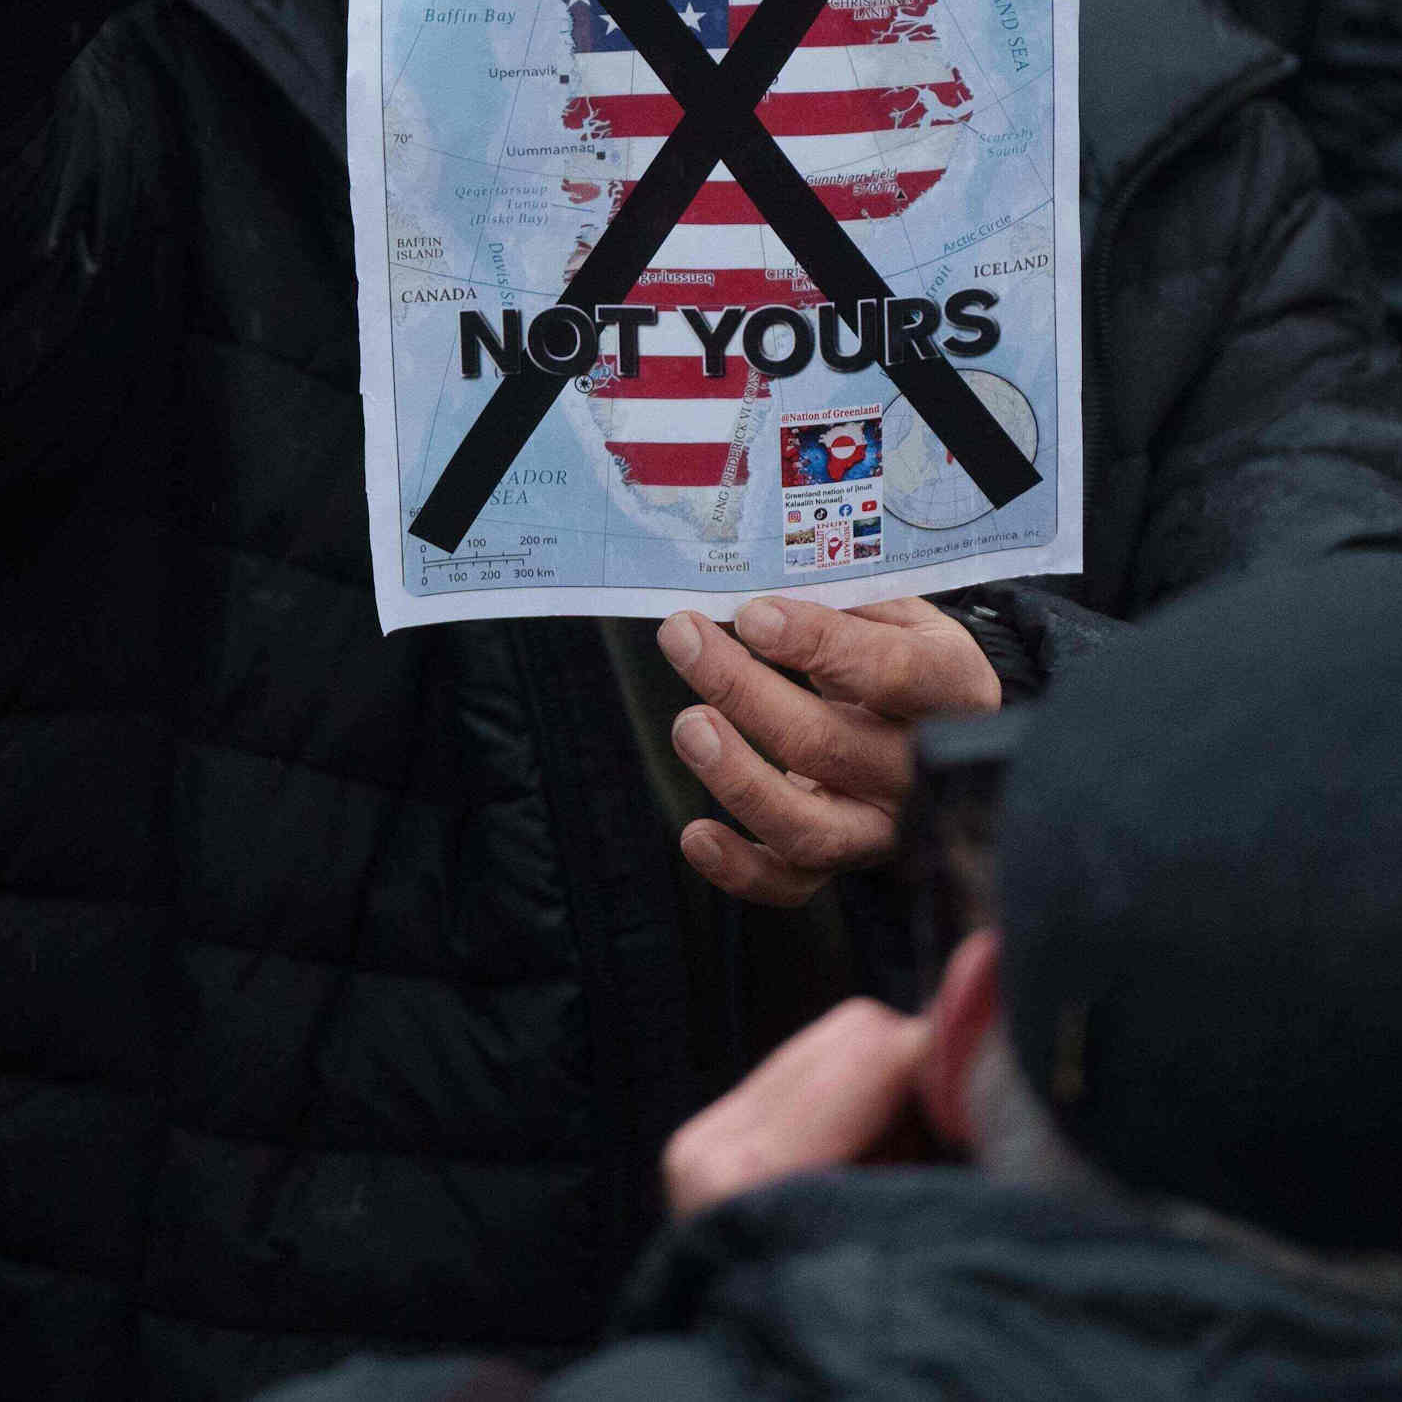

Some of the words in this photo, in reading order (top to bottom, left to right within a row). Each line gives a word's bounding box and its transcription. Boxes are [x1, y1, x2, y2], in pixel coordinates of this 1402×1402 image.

[424, 7, 477, 23] Baffin
[484, 8, 517, 24] Bay
[1007, 35, 1030, 73] SEA
[487, 66, 559, 81] Upernavik
[396, 248, 444, 260] ISLAND
[973, 254, 1048, 278] ICELAND
[401, 286, 478, 304] CANADA
[458, 303, 658, 378] NOT
[676, 288, 1001, 378] YOURS
[781, 412, 820, 424] @Nation
[821, 409, 832, 420] of
[833, 404, 880, 419] Greenland
[489, 489, 529, 506] SEA
[466, 538, 487, 548] 100
[519, 535, 541, 546] 200
[543, 535, 558, 545] mi
[708, 549, 739, 564] Cape
[480, 570, 501, 581] 200
[514, 568, 534, 579] 300
[536, 568, 555, 579] km
[699, 562, 750, 575] Farewell
[421, 577, 429, 586] 0
[448, 572, 468, 583] 100
